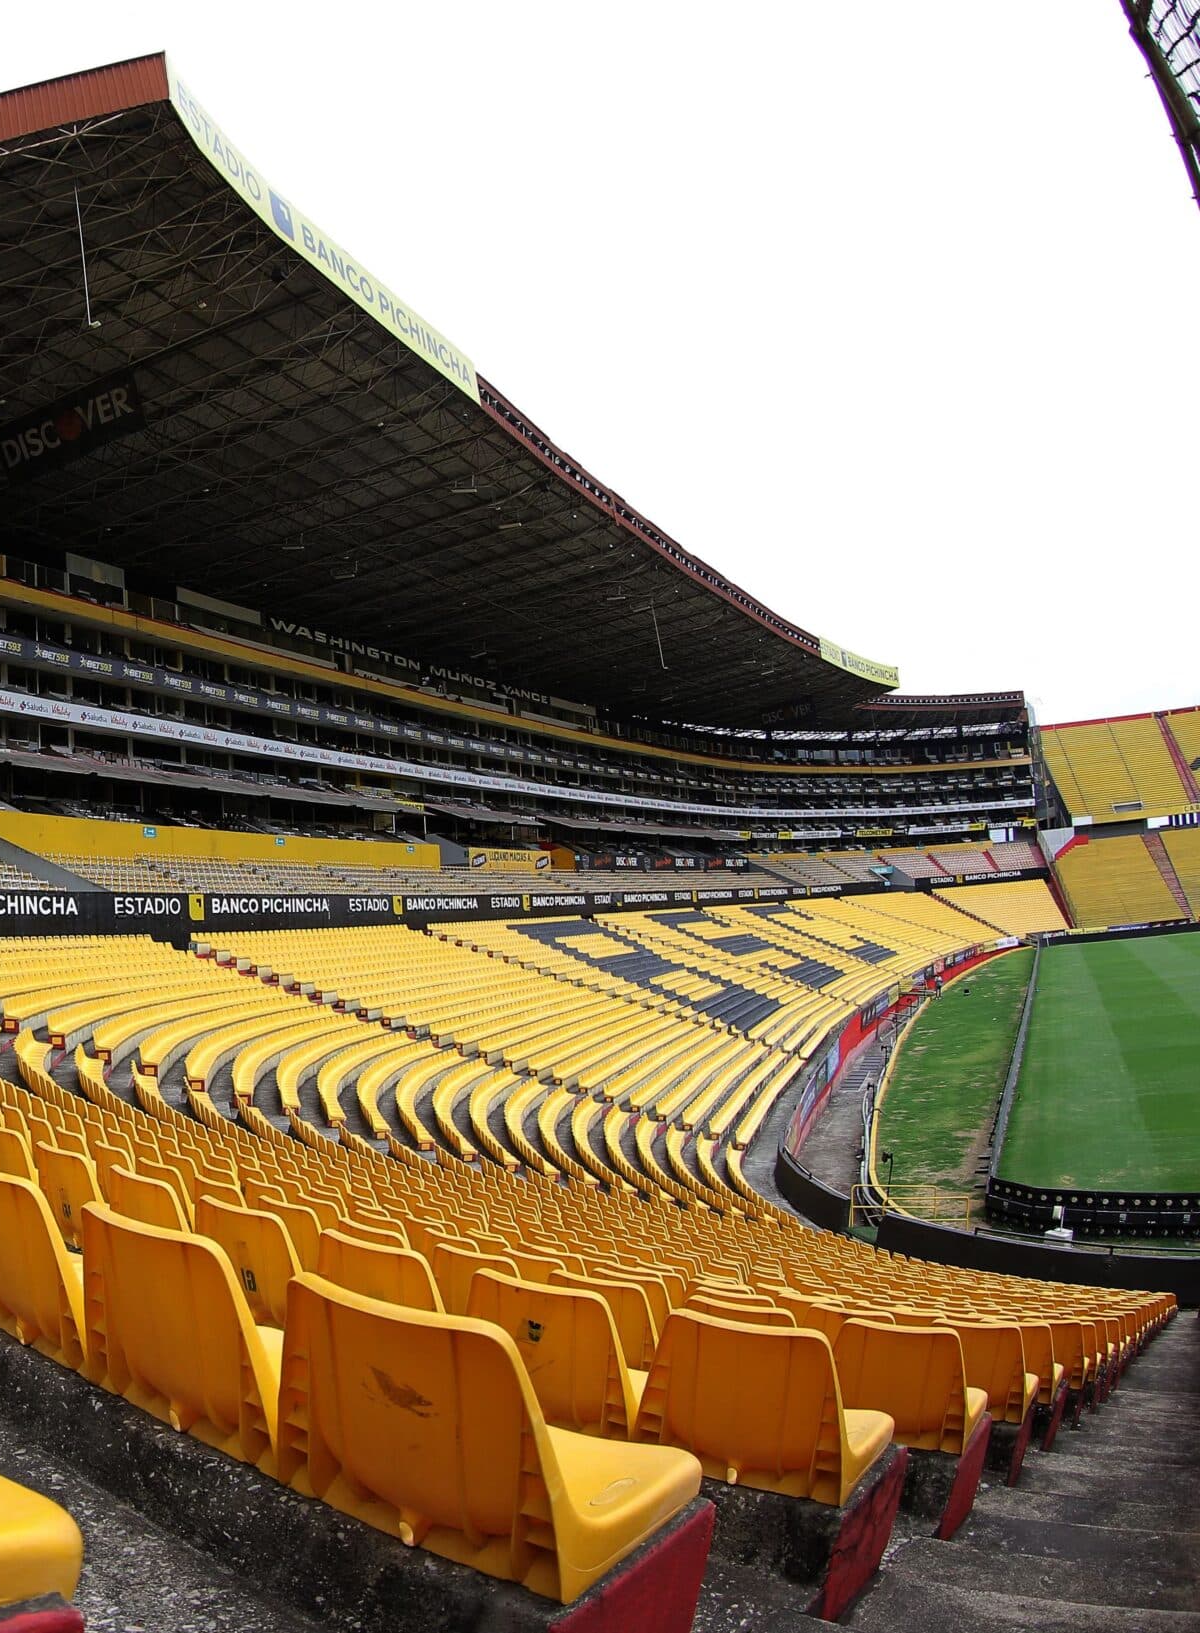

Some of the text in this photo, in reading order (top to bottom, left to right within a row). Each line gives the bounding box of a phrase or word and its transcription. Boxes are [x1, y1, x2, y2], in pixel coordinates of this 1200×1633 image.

[176, 79, 472, 387] ESTADIO BANCO PICHINCHA
[270, 617, 421, 671] WASHINGTON
[930, 876, 954, 884] ESTADIO
[988, 870, 1021, 879] PICHINCHA
[349, 898, 478, 912] ESTADIO BANCO PICHINCHA
[491, 896, 586, 908] ESTADIO BANCO PICHINCHA
[594, 892, 668, 905] ESTADI BANCO PICHINCHA
[114, 897, 330, 916] ESTADIO BANCO PICHINCHA
